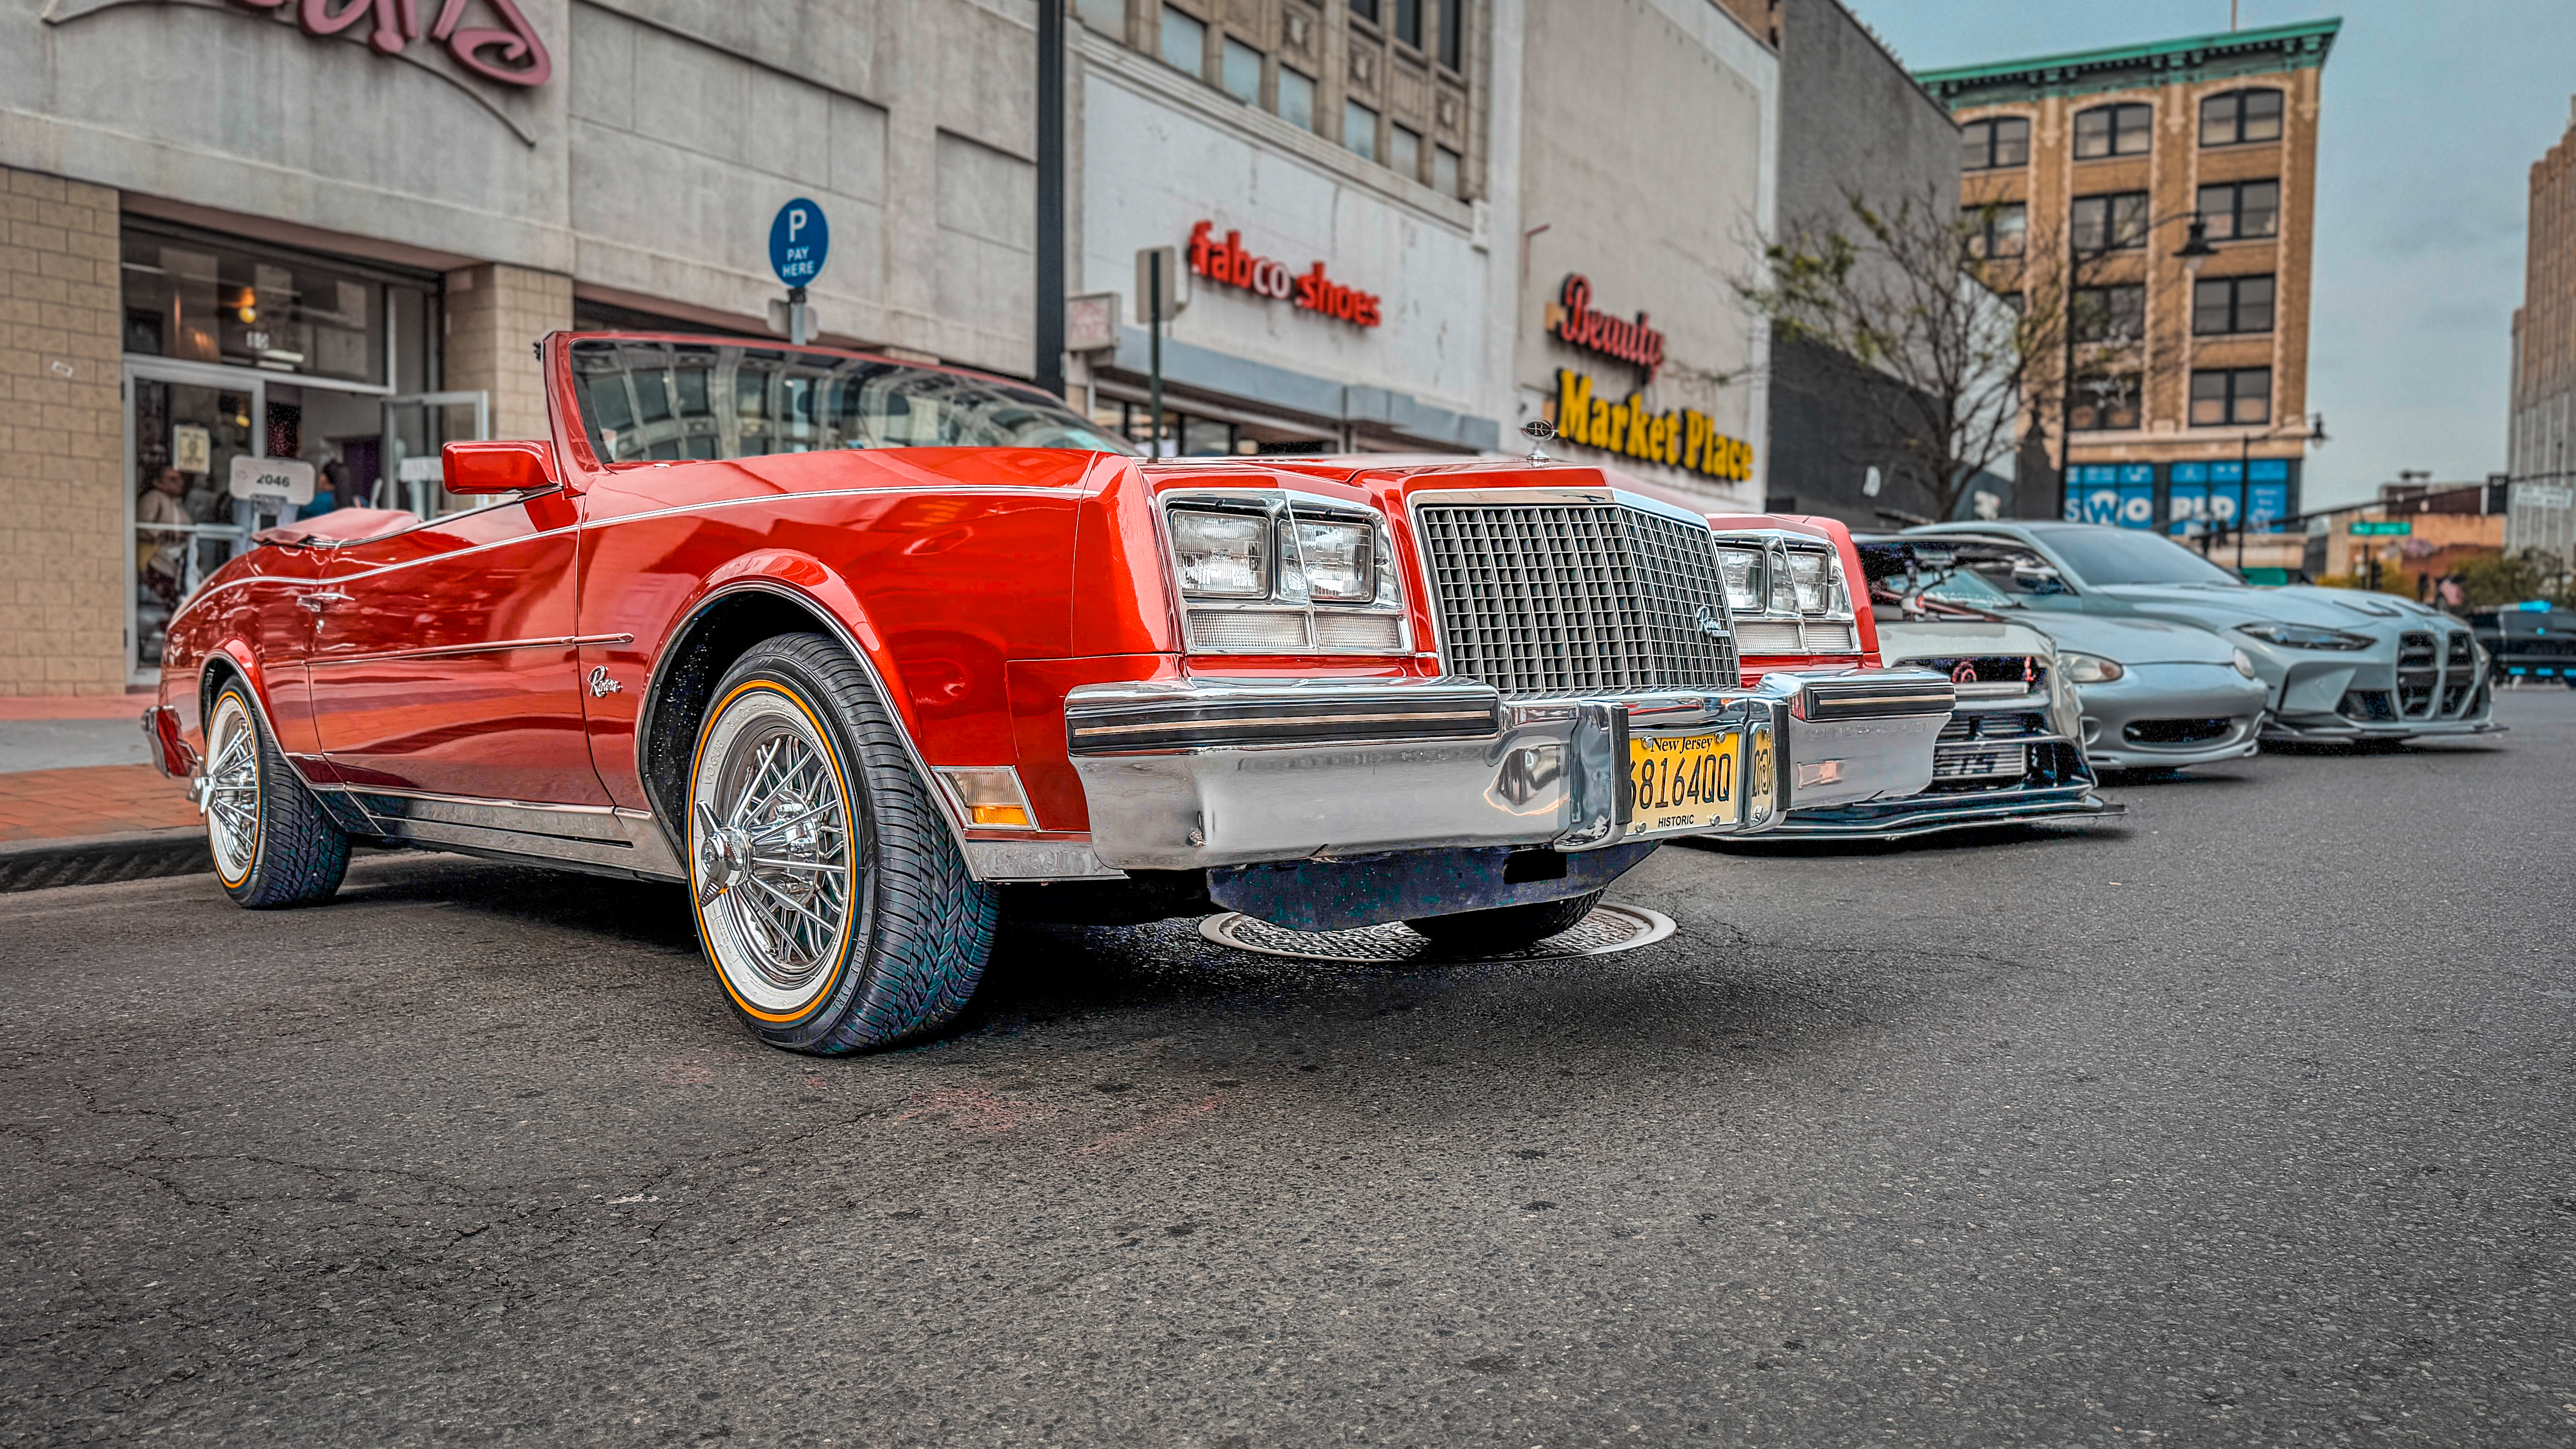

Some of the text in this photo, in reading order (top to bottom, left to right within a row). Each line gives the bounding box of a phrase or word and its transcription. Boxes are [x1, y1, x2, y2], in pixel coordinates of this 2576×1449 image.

[788, 209, 807, 243] P
[787, 246, 809, 261] PAY
[782, 261, 814, 277] HERE
[1560, 274, 1665, 386] Beauty
[1559, 369, 1754, 482] Market Place
[256, 474, 290, 487] 2046
[1650, 737, 1713, 754] New Jersey
[704, 739, 725, 784] VOGUE
[1658, 814, 1694, 828] HISTORIC
[833, 932, 868, 1010] VOGUE TYRE
